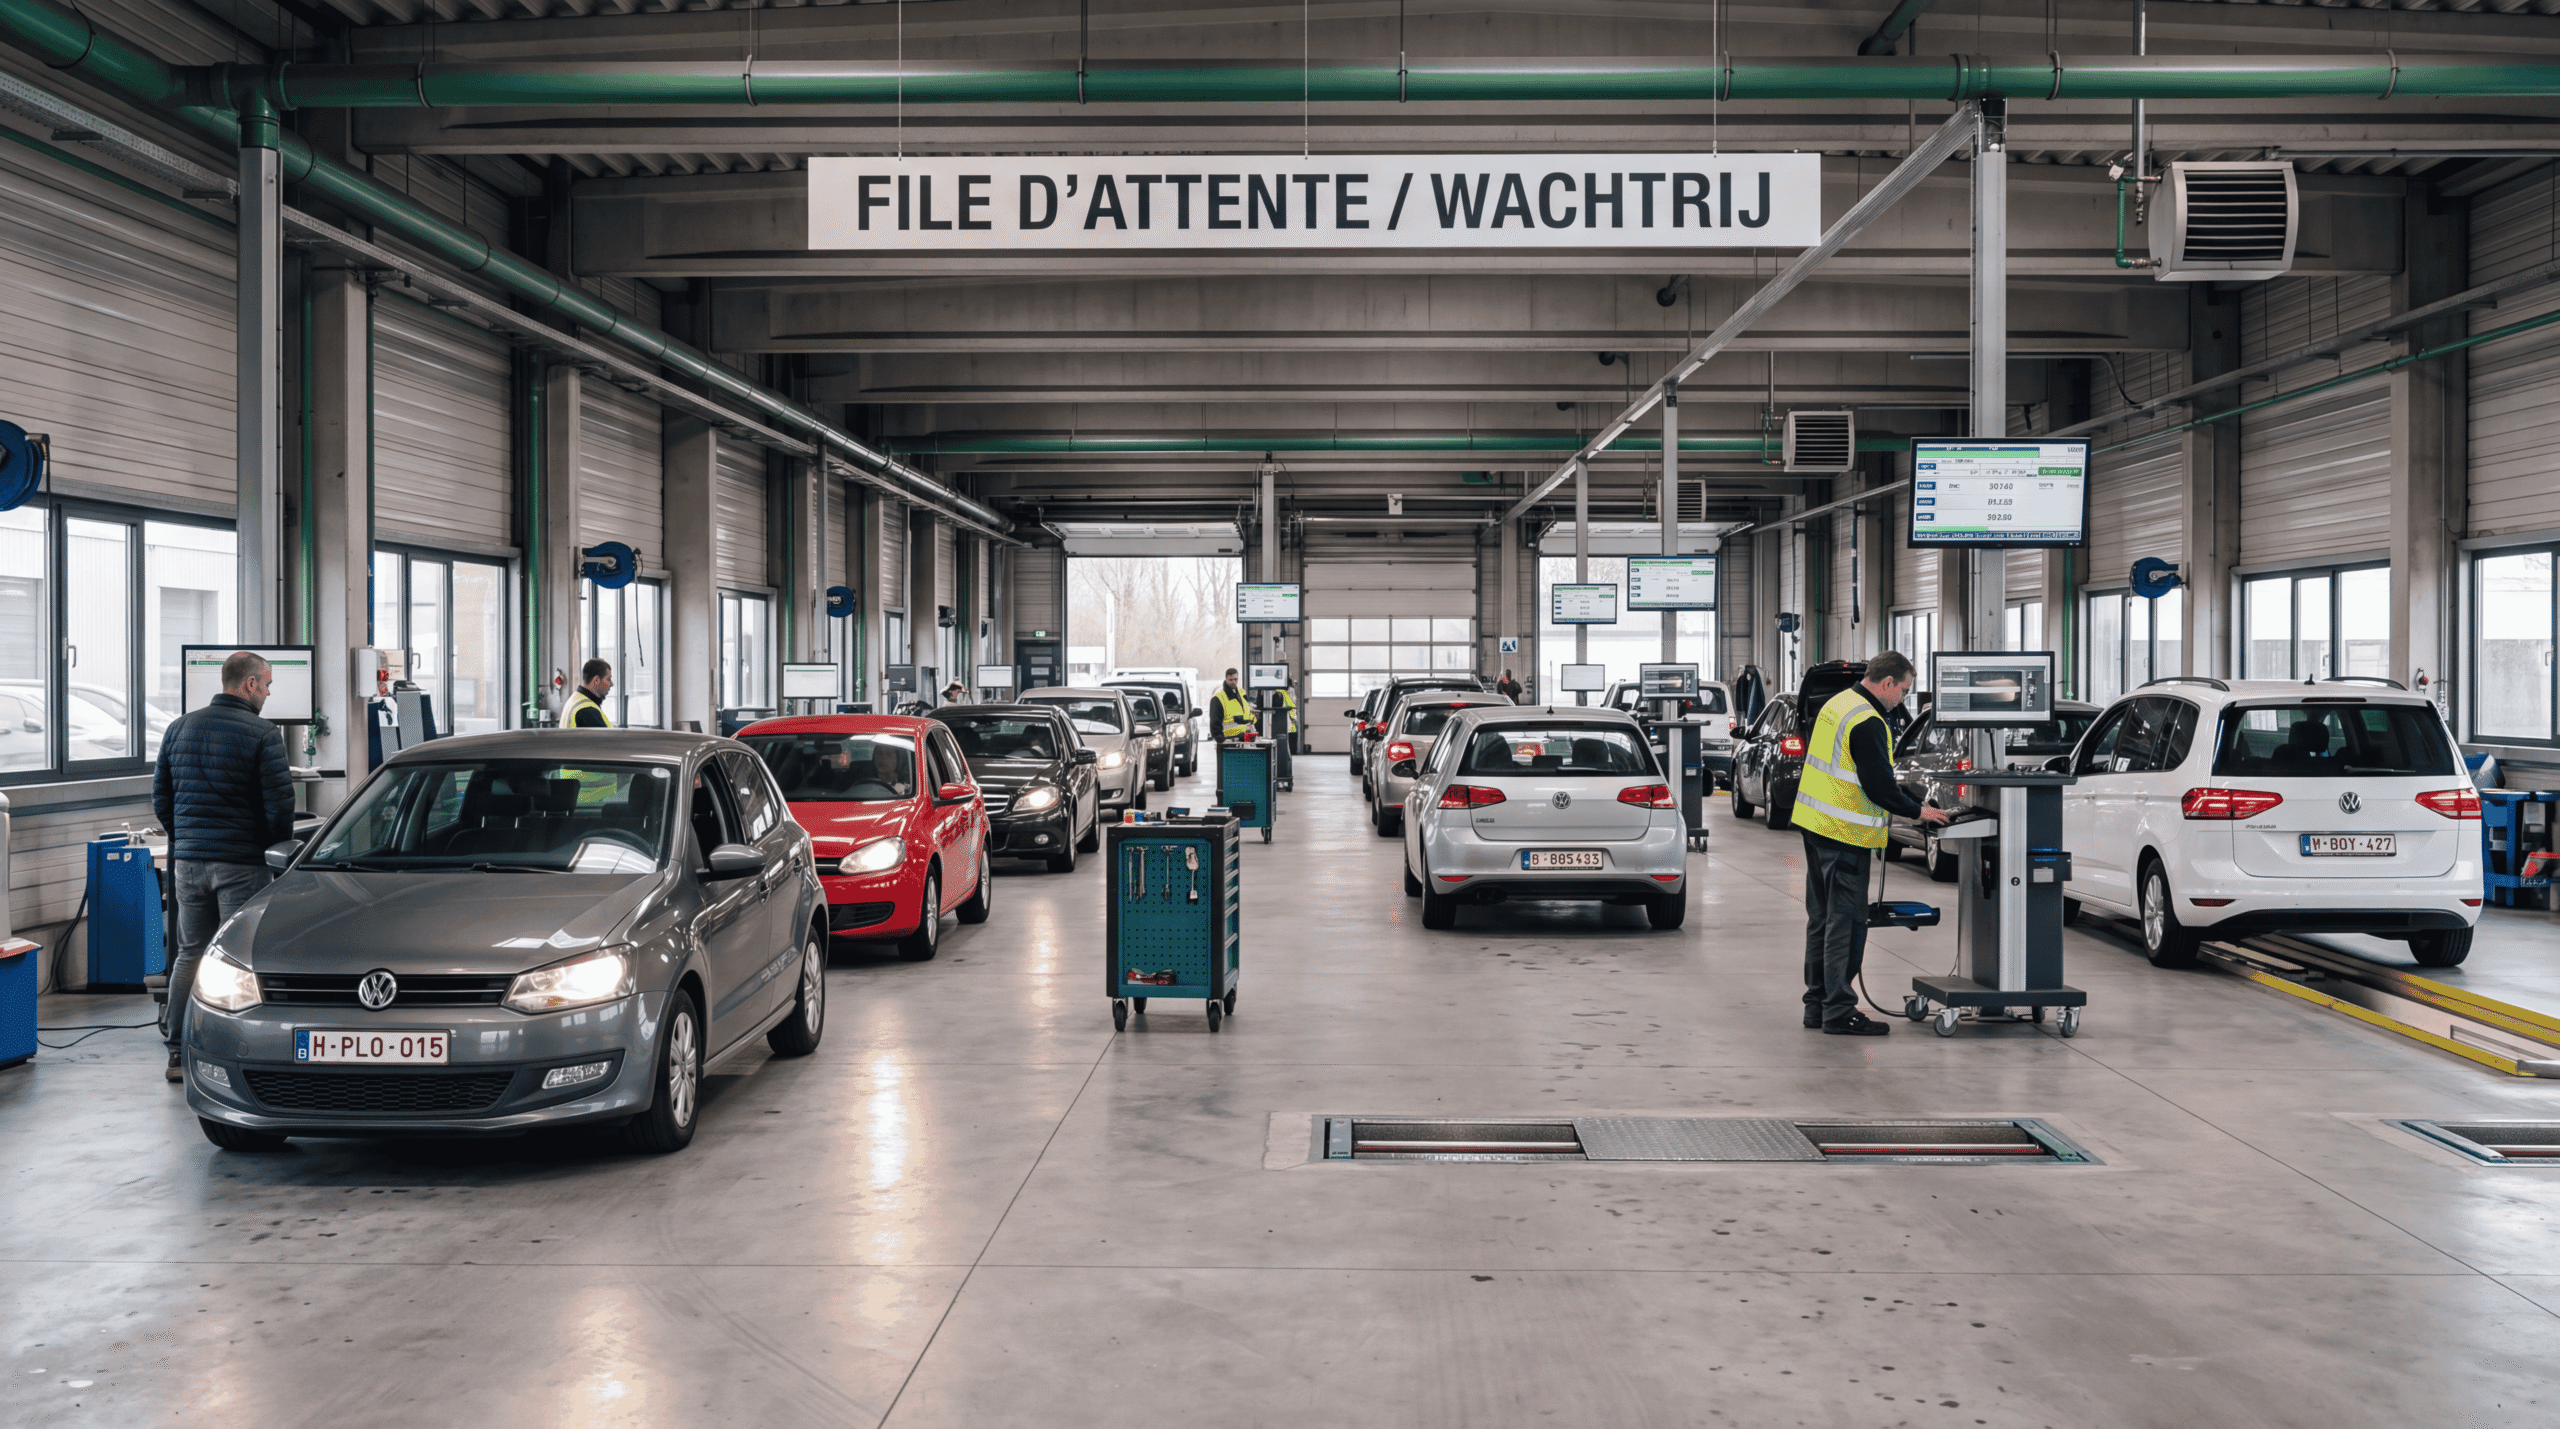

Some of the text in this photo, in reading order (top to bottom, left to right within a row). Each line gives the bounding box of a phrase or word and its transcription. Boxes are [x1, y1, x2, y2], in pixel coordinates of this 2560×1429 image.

[858, 172, 1770, 231] FILE D’ATTENTE / WACHTRIJ
[297, 1048, 307, 1059] B
[313, 1036, 443, 1058] H-PLO-015
